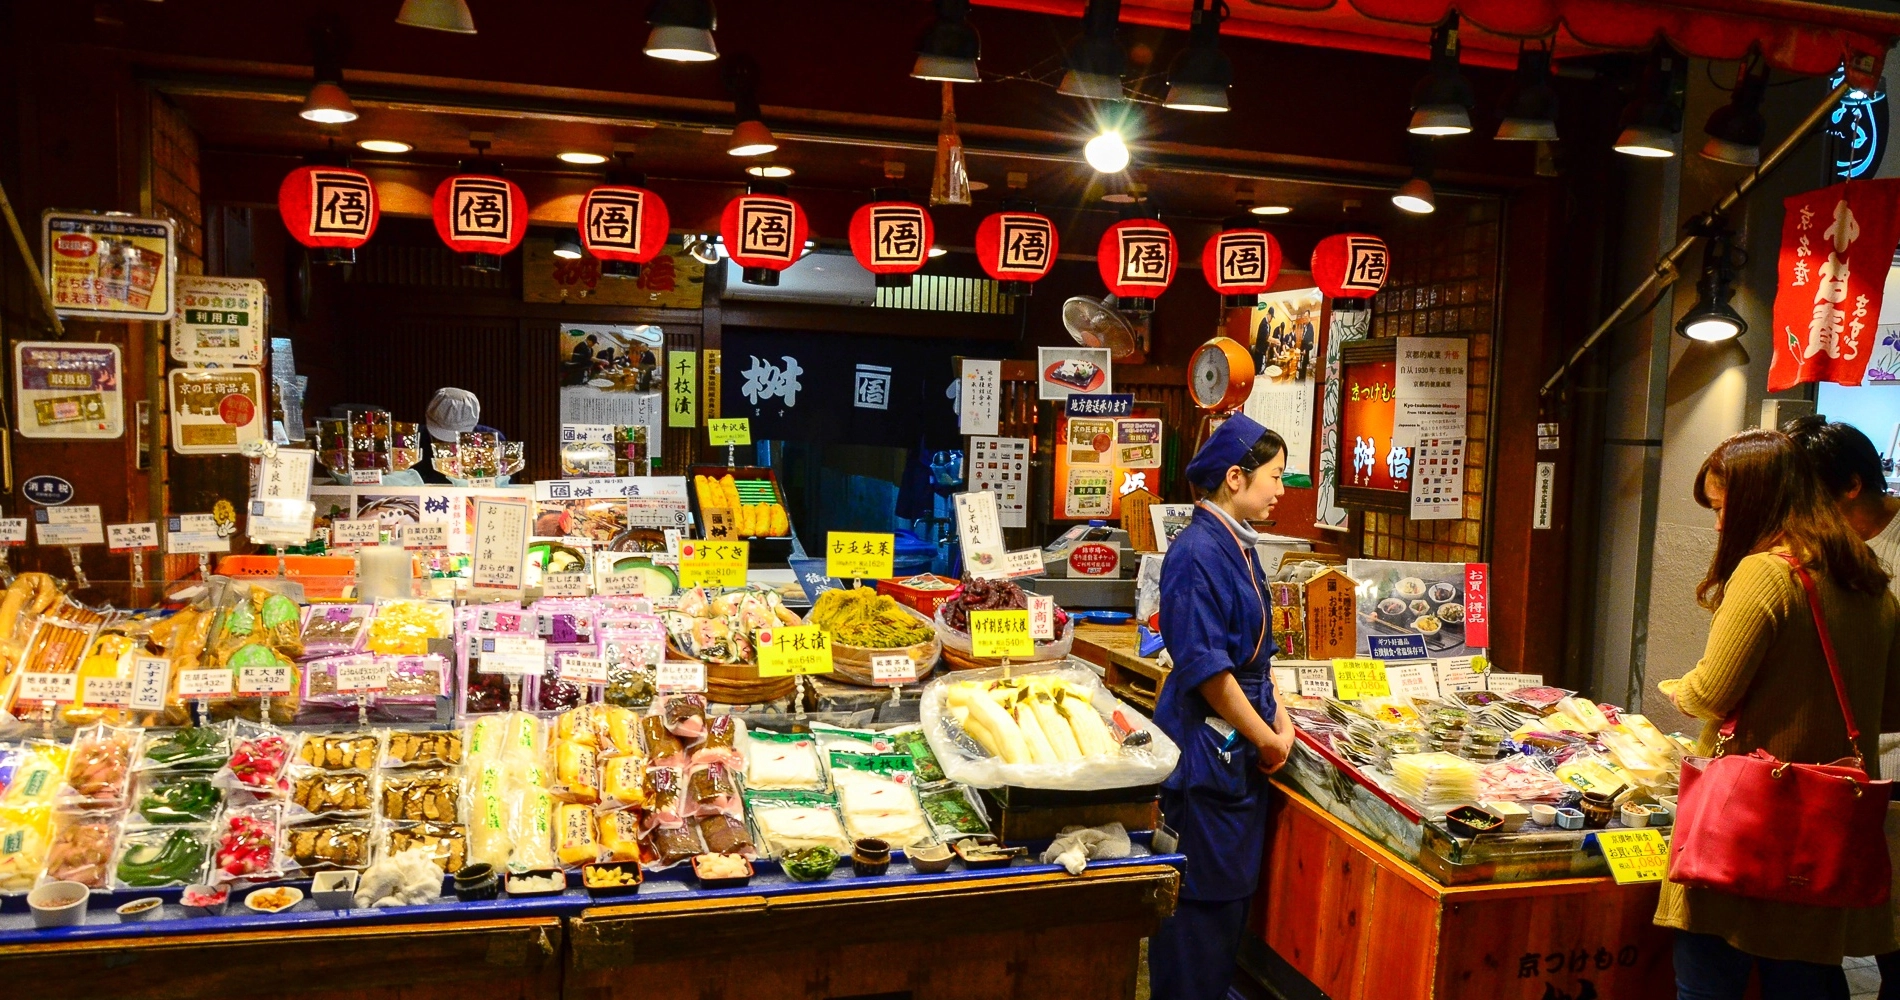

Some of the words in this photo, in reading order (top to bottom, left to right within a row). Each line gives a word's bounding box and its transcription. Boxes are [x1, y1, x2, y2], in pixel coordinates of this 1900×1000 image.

[196, 311, 238, 325] 利用店
[51, 373, 88, 386] 取扱店
[179, 382, 251, 395] 京の匠商品券
[673, 358, 692, 415] 千枚漬
[1070, 398, 1128, 414] 地方発送承ります
[267, 458, 284, 496] 奈良漬
[28, 482, 69, 494] 消費税
[339, 523, 375, 531] 花みょうが
[967, 503, 981, 545] しそ胡瓜
[407, 527, 443, 535] 白菜の古漬
[483, 505, 498, 560] おらが漬
[696, 545, 743, 560] すぐき
[479, 563, 515, 573] おらが漬
[548, 575, 581, 583] 生しば漬
[605, 575, 639, 584] 刻みすぐき
[1467, 569, 1486, 624] お買い得品
[1033, 598, 1048, 635] 新商品
[1328, 595, 1338, 647] お漬けもの
[774, 630, 828, 653] 千枚漬
[1378, 637, 1411, 646] ギフト好適品
[244, 668, 285, 677] 紅大根
[1367, 669, 1377, 680] 4
[88, 681, 132, 689] みょうが漬
[864, 758, 909, 769] 千枚漬
[1611, 832, 1653, 845] 京漬物(個食)
[1643, 841, 1655, 855] 4
[1517, 944, 1639, 979] 京つけもの
